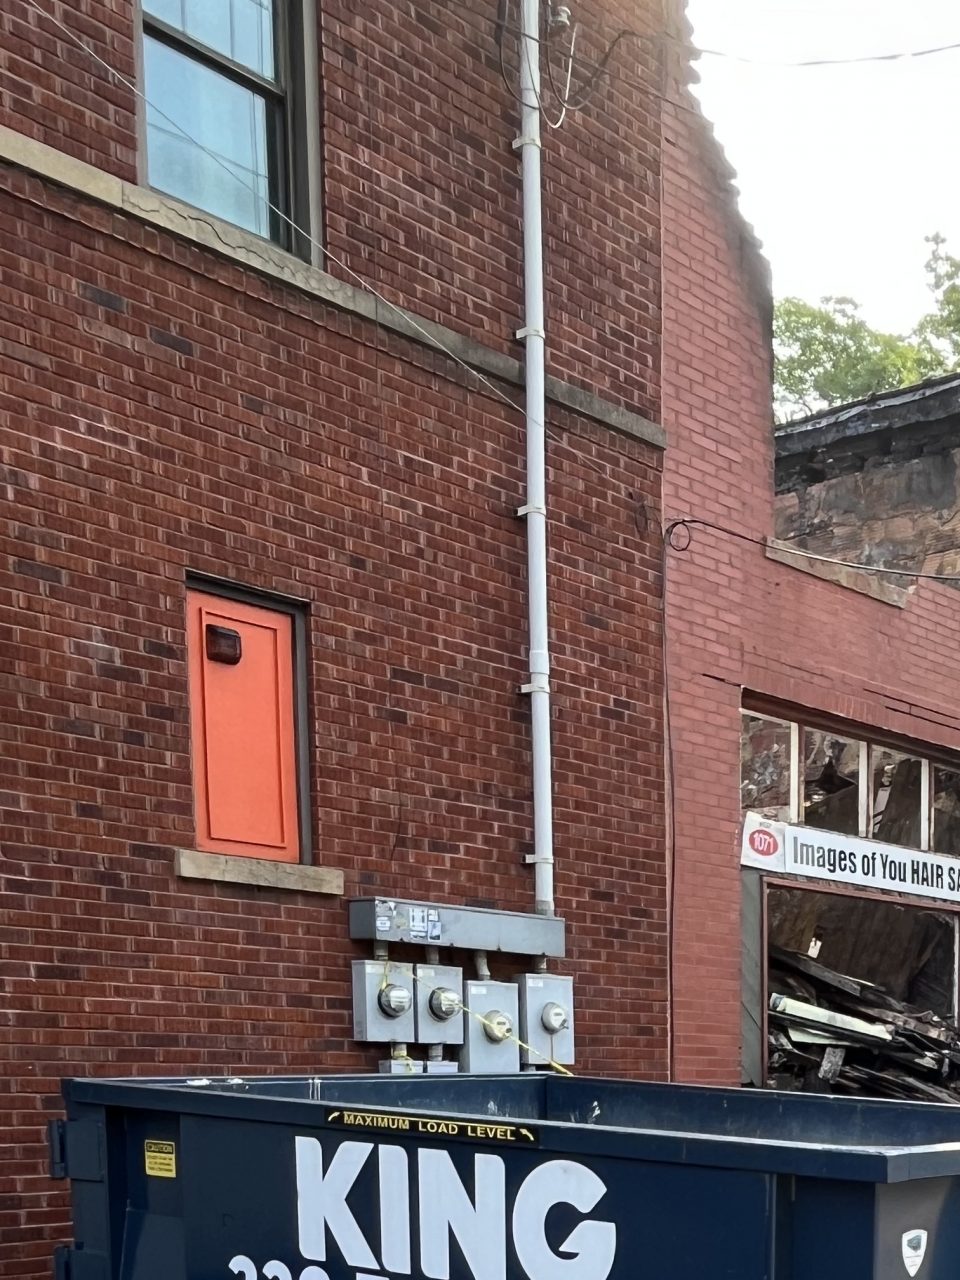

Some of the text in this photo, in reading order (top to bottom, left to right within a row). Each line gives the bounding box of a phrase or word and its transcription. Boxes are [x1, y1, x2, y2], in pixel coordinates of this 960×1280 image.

[753, 832, 774, 853] 1071
[793, 836, 857, 873] Images
[861, 852, 877, 877] of
[880, 853, 907, 882] You
[911, 859, 944, 889] HAIR
[343, 1113, 517, 1140] MAXIMUM LOAD LEVEL
